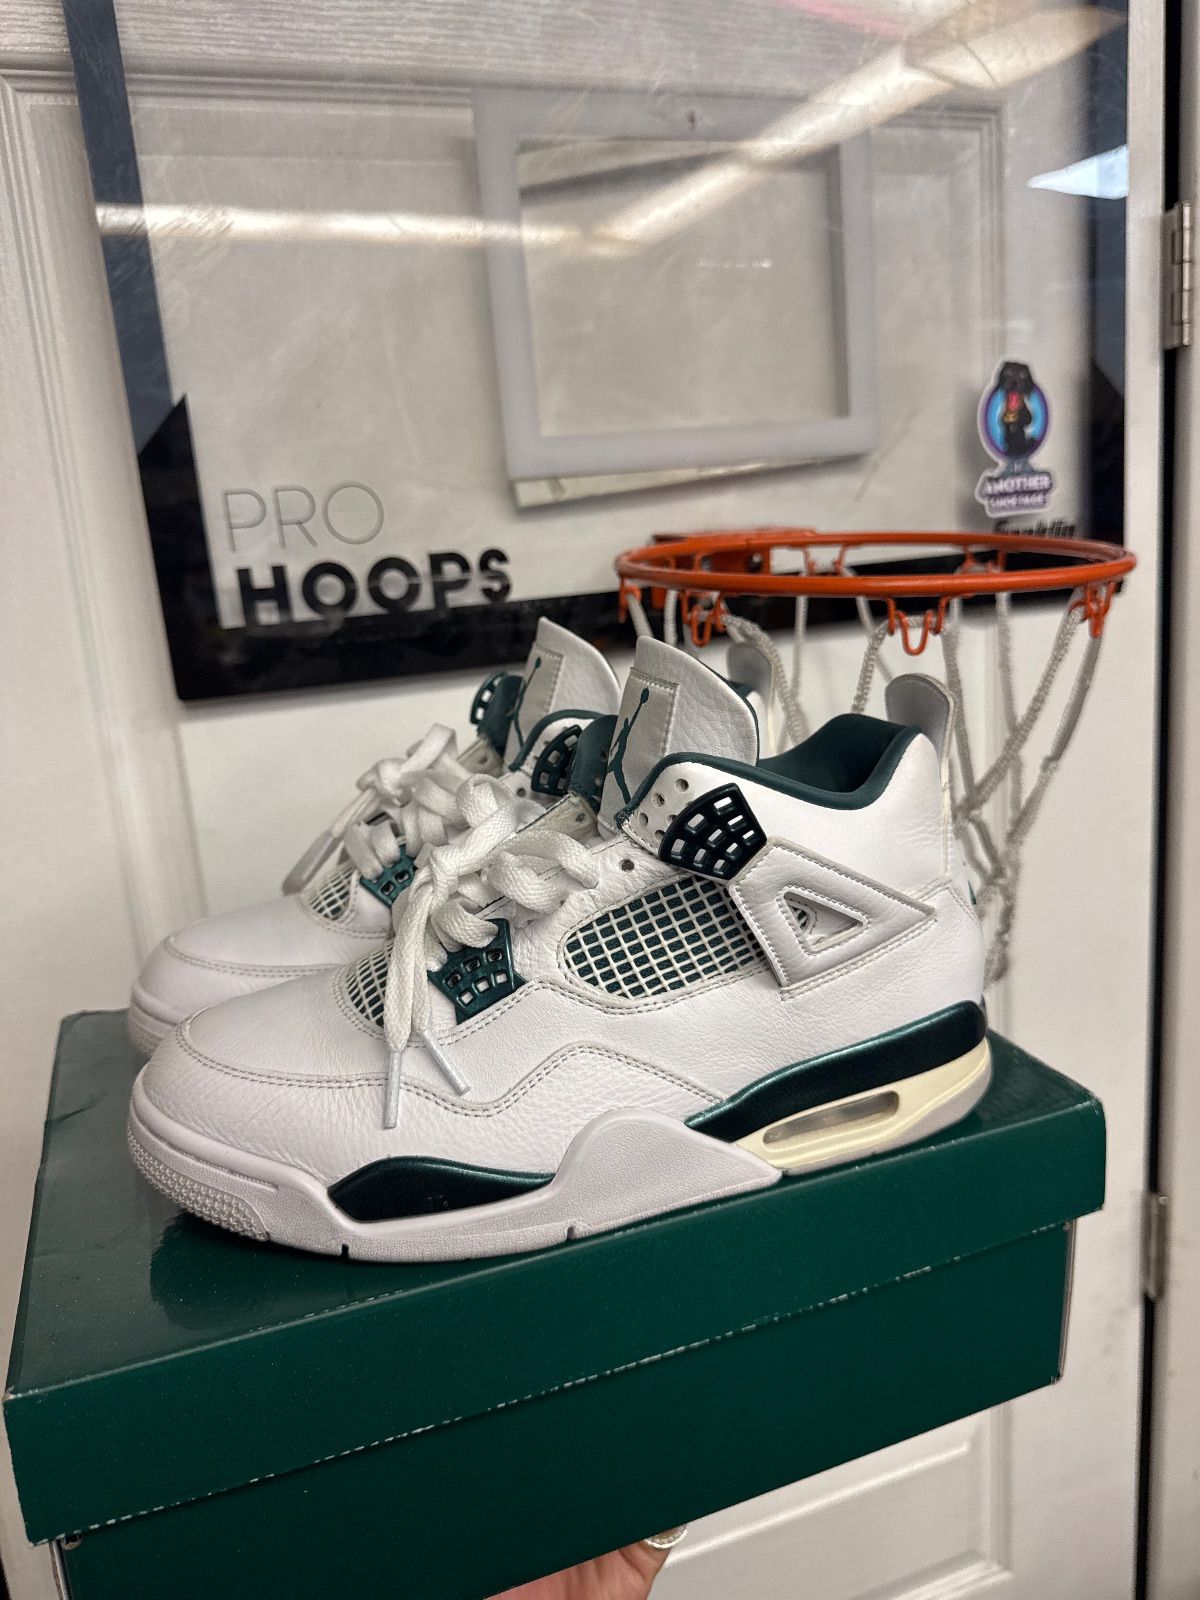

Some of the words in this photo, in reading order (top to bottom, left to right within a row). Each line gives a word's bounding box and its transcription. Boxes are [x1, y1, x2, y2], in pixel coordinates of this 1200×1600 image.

[222, 480, 384, 552] PRO
[984, 475, 1050, 495] ANOTHER
[236, 548, 512, 623] HOOPS
